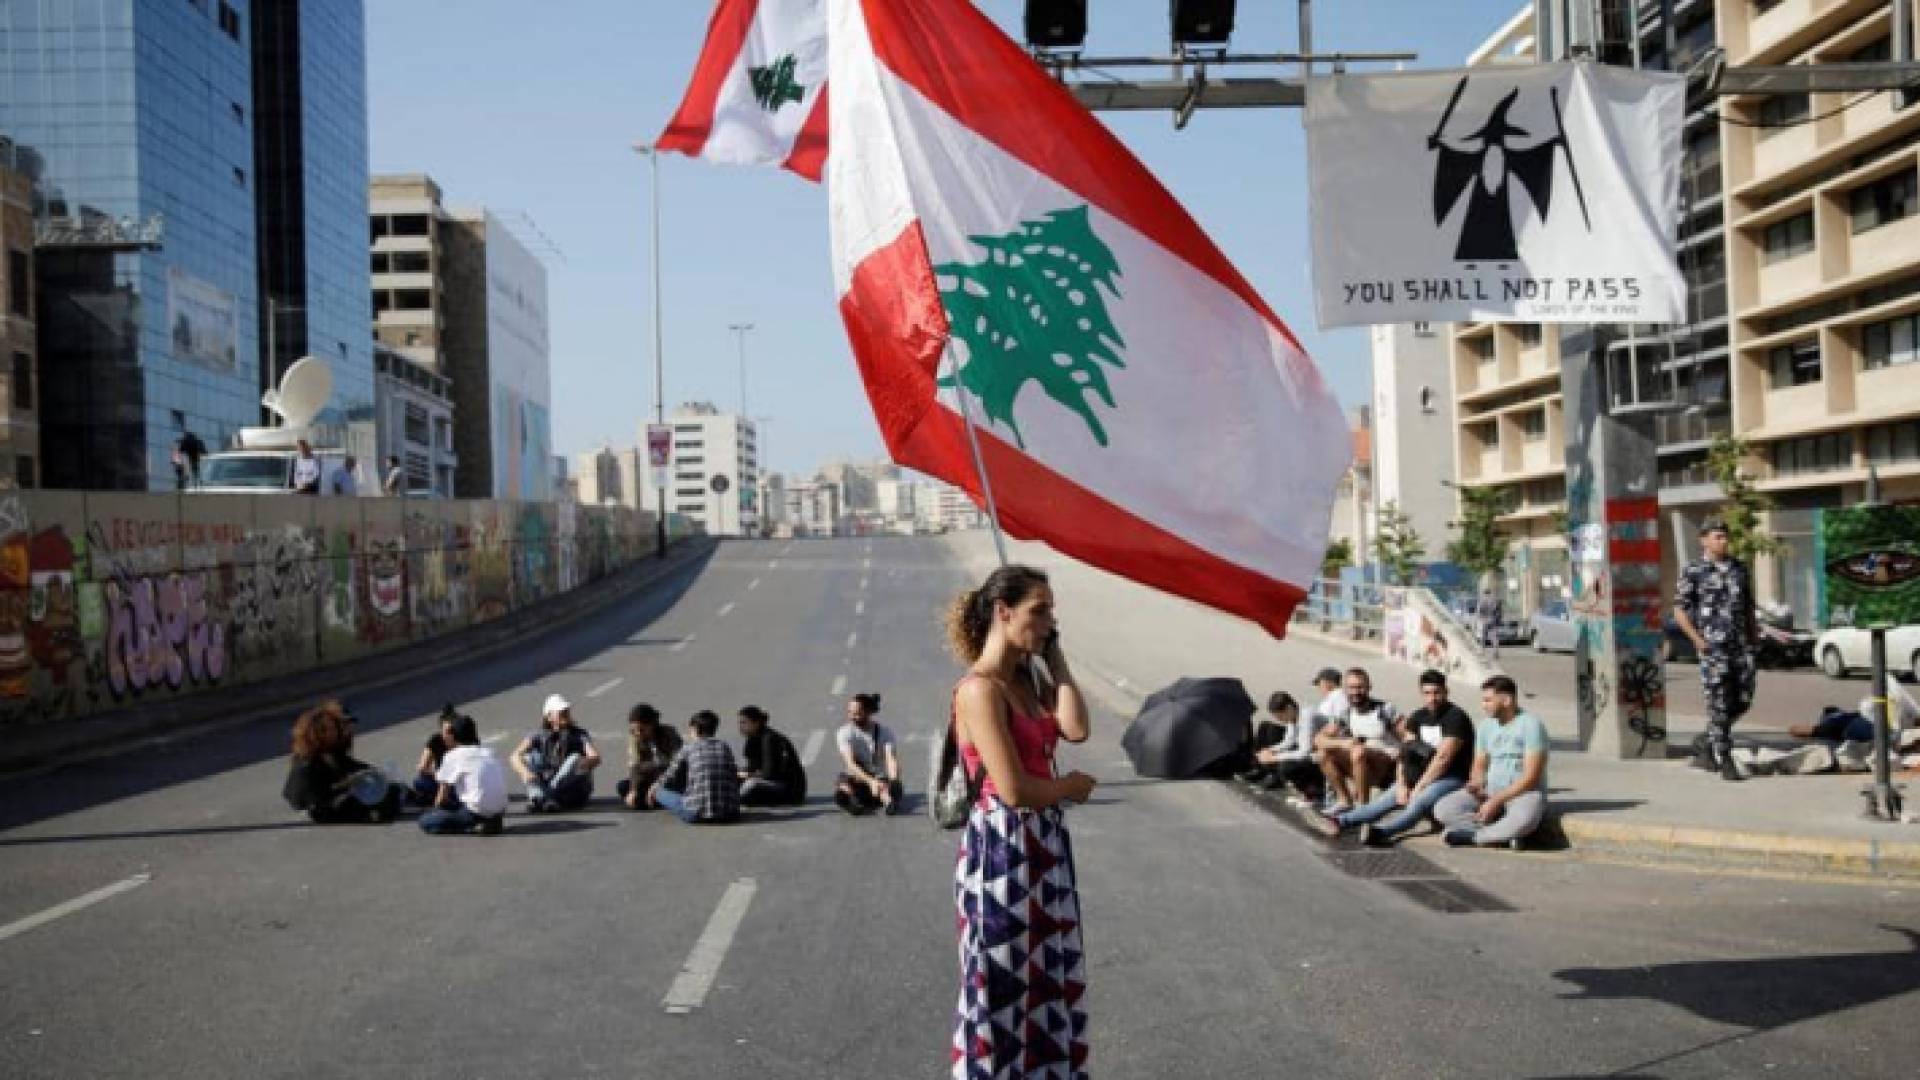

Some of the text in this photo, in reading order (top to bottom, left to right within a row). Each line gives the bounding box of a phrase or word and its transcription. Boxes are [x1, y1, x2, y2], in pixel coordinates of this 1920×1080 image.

[1343, 277, 1641, 304] YOU SHALL NOT PASS
